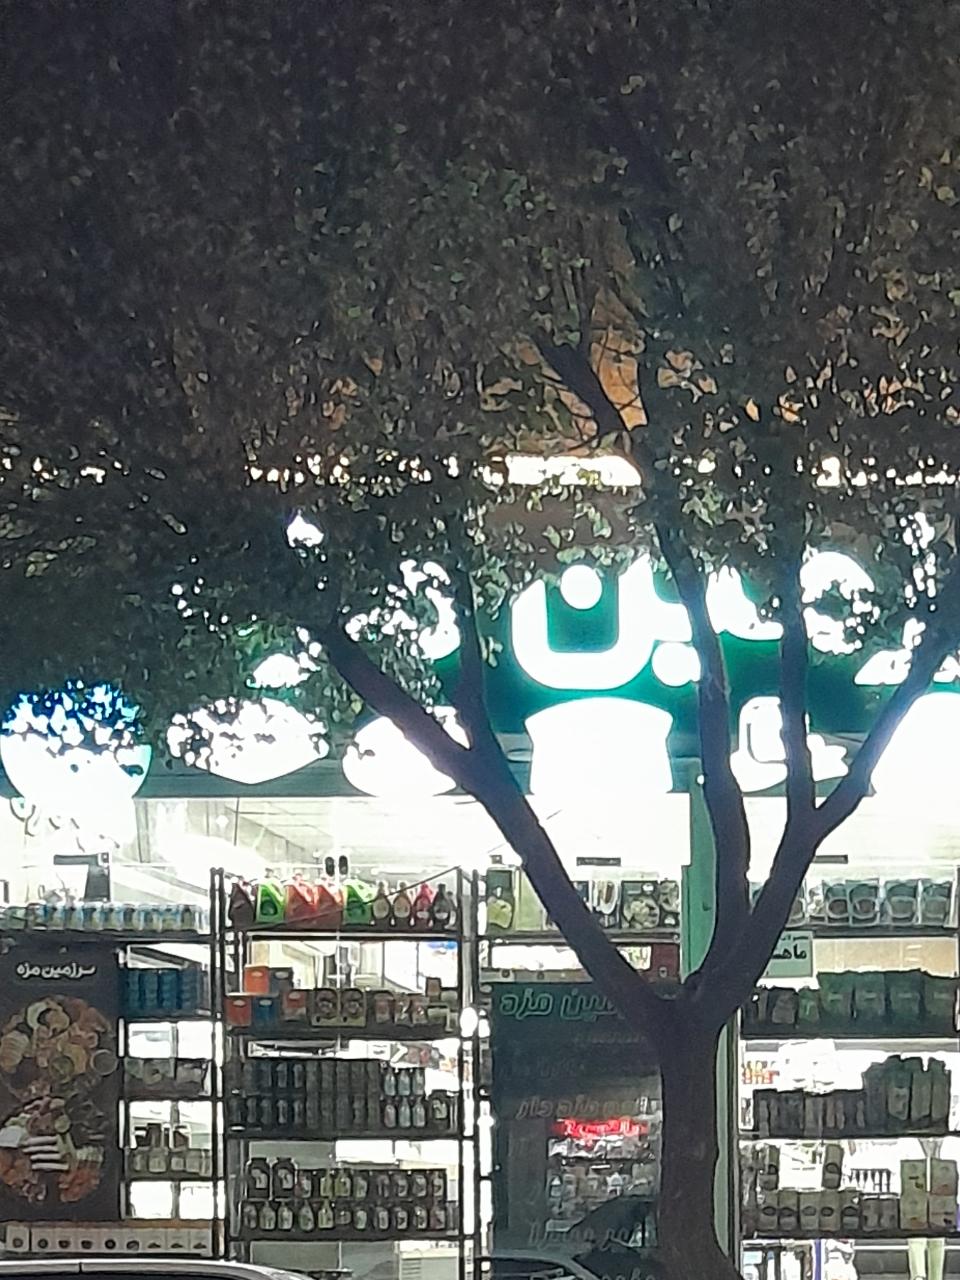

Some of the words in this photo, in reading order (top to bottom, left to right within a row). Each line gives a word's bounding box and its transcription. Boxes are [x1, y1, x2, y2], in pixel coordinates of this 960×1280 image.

[17, 962, 41, 978] مزه
[41, 962, 96, 978] سرزمین
[500, 987, 553, 1020] مزه
